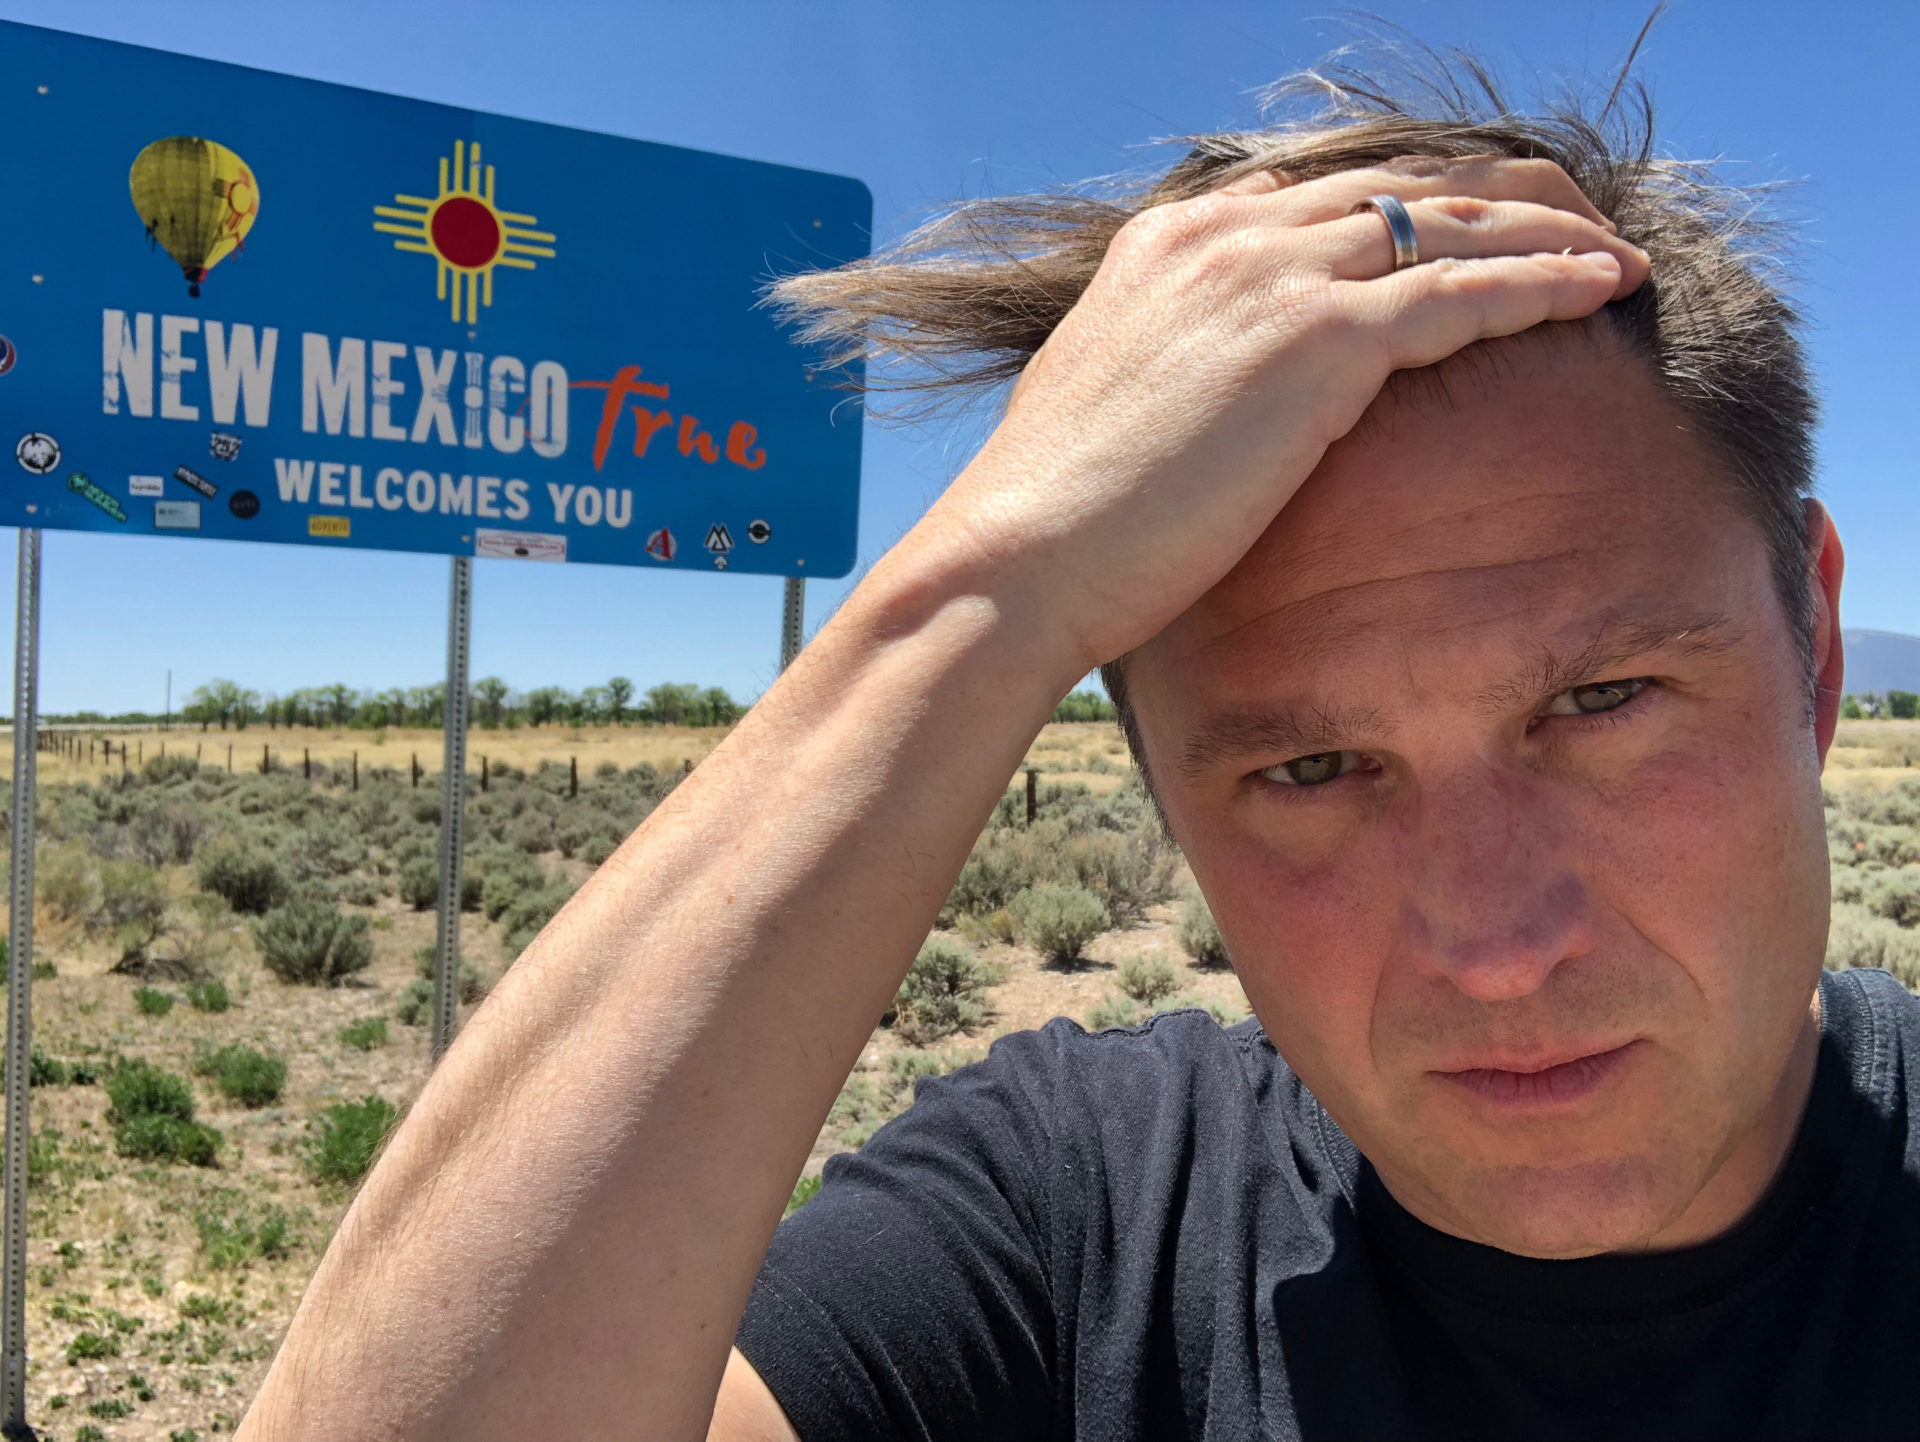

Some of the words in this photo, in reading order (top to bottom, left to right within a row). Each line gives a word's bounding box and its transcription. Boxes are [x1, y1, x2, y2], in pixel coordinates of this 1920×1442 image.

[103, 309, 278, 427] NEW
[302, 332, 569, 458] MEXICO
[567, 364, 767, 472] True
[274, 458, 530, 520] WELCOMES
[547, 482, 633, 529] YOU
